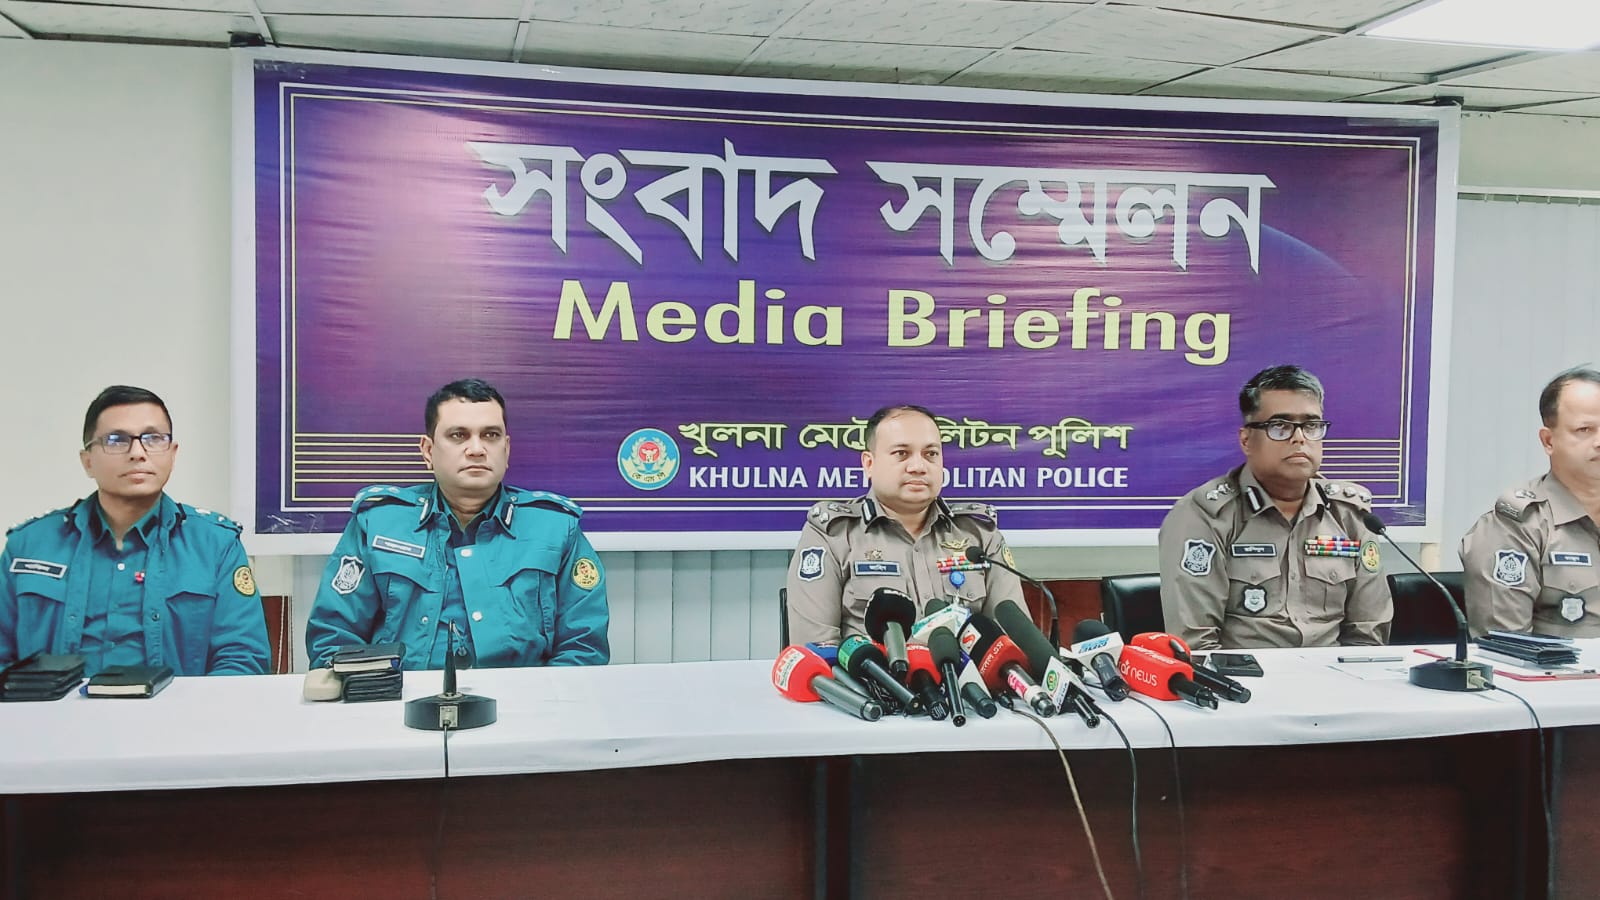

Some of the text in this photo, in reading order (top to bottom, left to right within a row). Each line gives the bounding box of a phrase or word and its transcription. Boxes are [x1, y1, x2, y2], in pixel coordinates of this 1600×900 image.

[465, 137, 1277, 275] সংবাদ সম্মেলন
[552, 279, 1233, 366] Media Briefing
[678, 422, 788, 458] খুলনা
[1027, 416, 1134, 459] পুলিশ
[689, 466, 808, 489] KHULNA
[1037, 466, 1129, 489] POLICE
